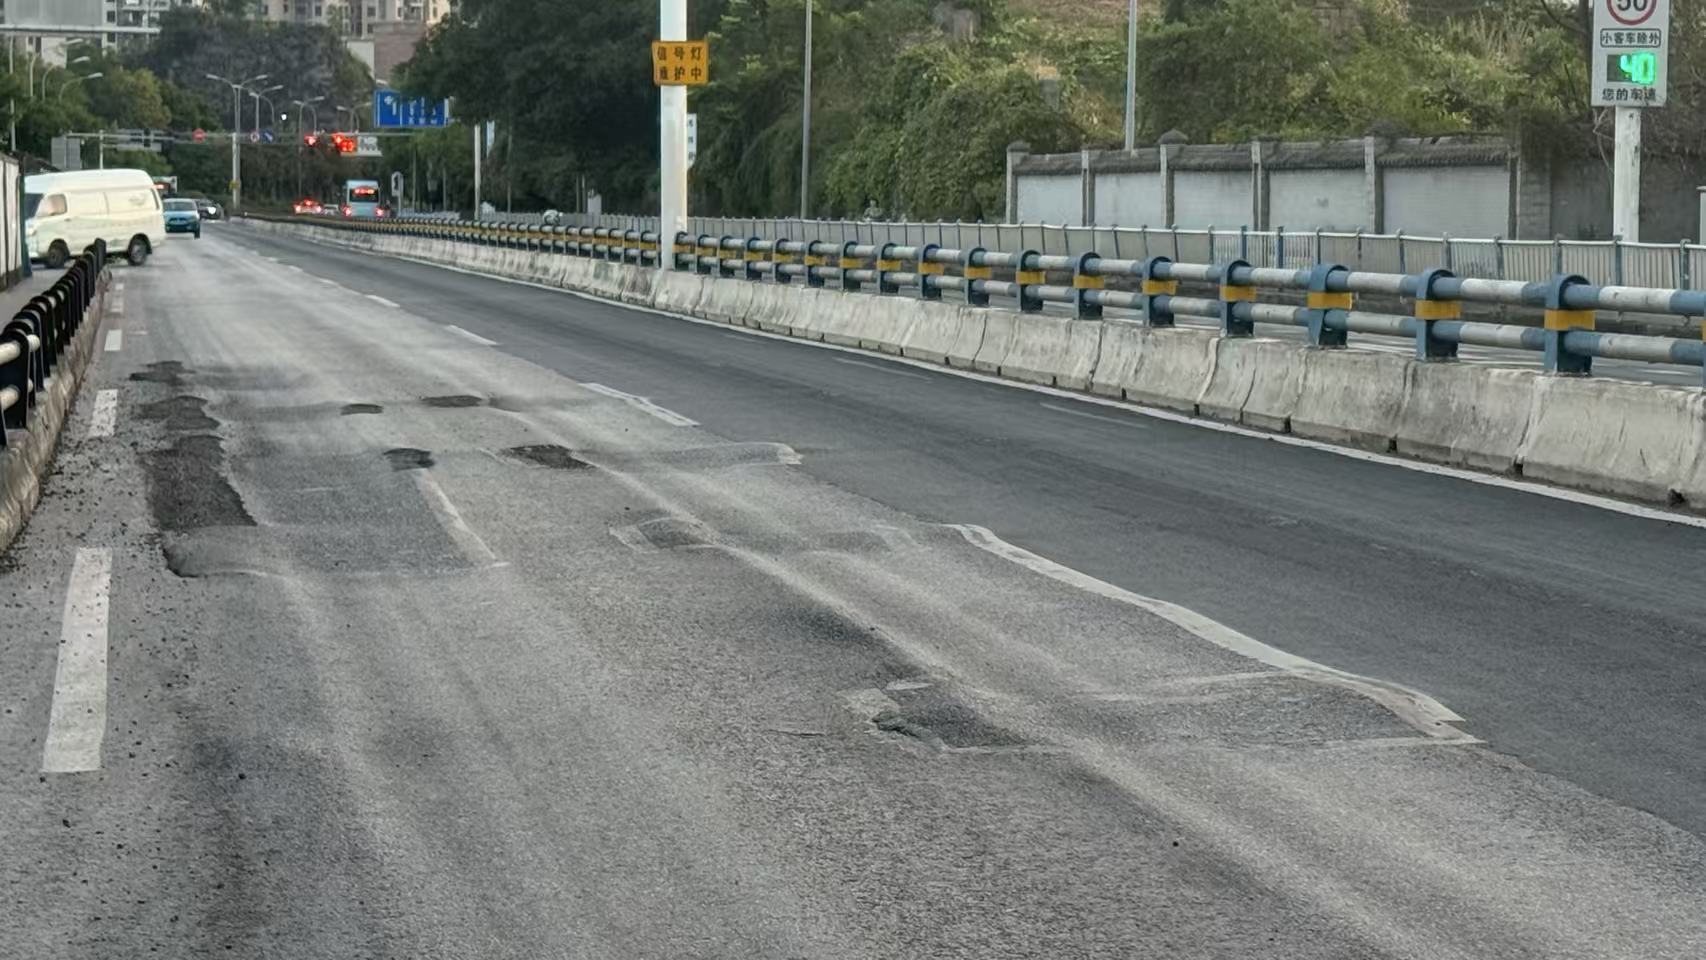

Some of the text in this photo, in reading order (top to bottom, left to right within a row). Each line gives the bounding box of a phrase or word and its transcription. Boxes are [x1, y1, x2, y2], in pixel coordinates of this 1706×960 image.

[1602, 32, 1660, 44] 小客车除外
[657, 46, 702, 61] 信号灯
[1620, 53, 1655, 84] 40
[1602, 87, 1657, 101] 您的车速
